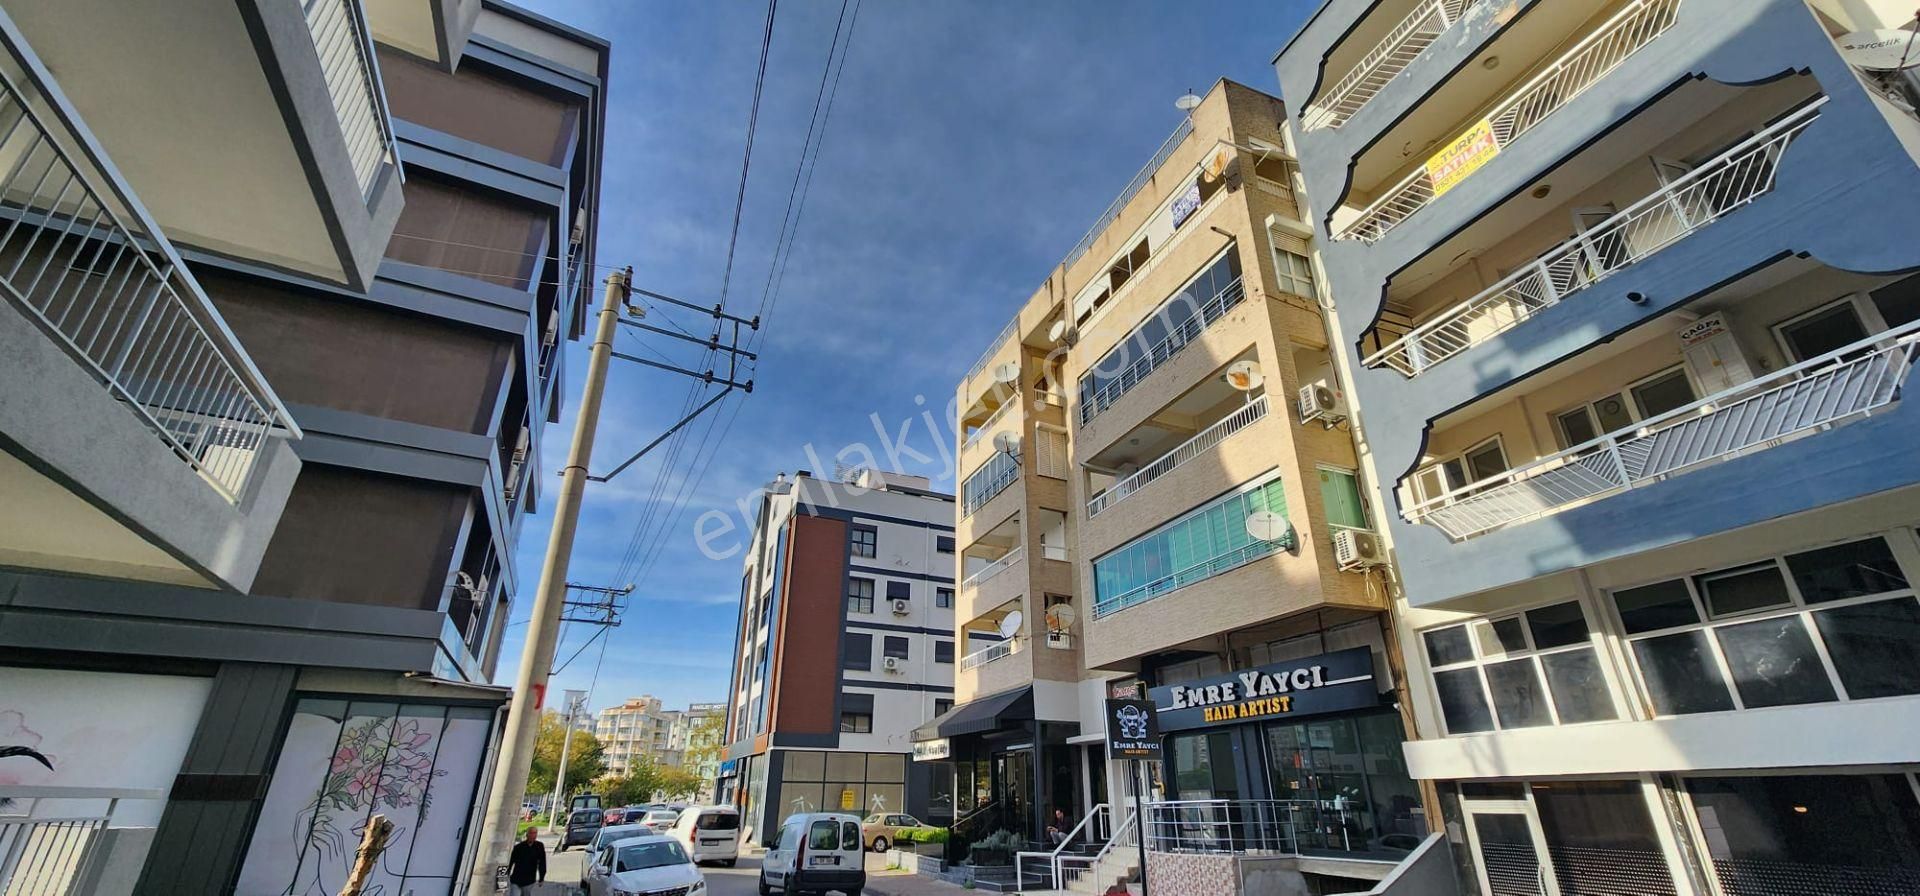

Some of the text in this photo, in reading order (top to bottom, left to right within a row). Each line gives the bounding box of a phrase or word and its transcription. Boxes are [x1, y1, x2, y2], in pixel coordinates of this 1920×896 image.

[1857, 38, 1901, 50] arcelik
[1171, 682, 1236, 709] EMRE
[1204, 696, 1290, 722] HAIR ARTIST
[1113, 741, 1136, 749] EMRE
